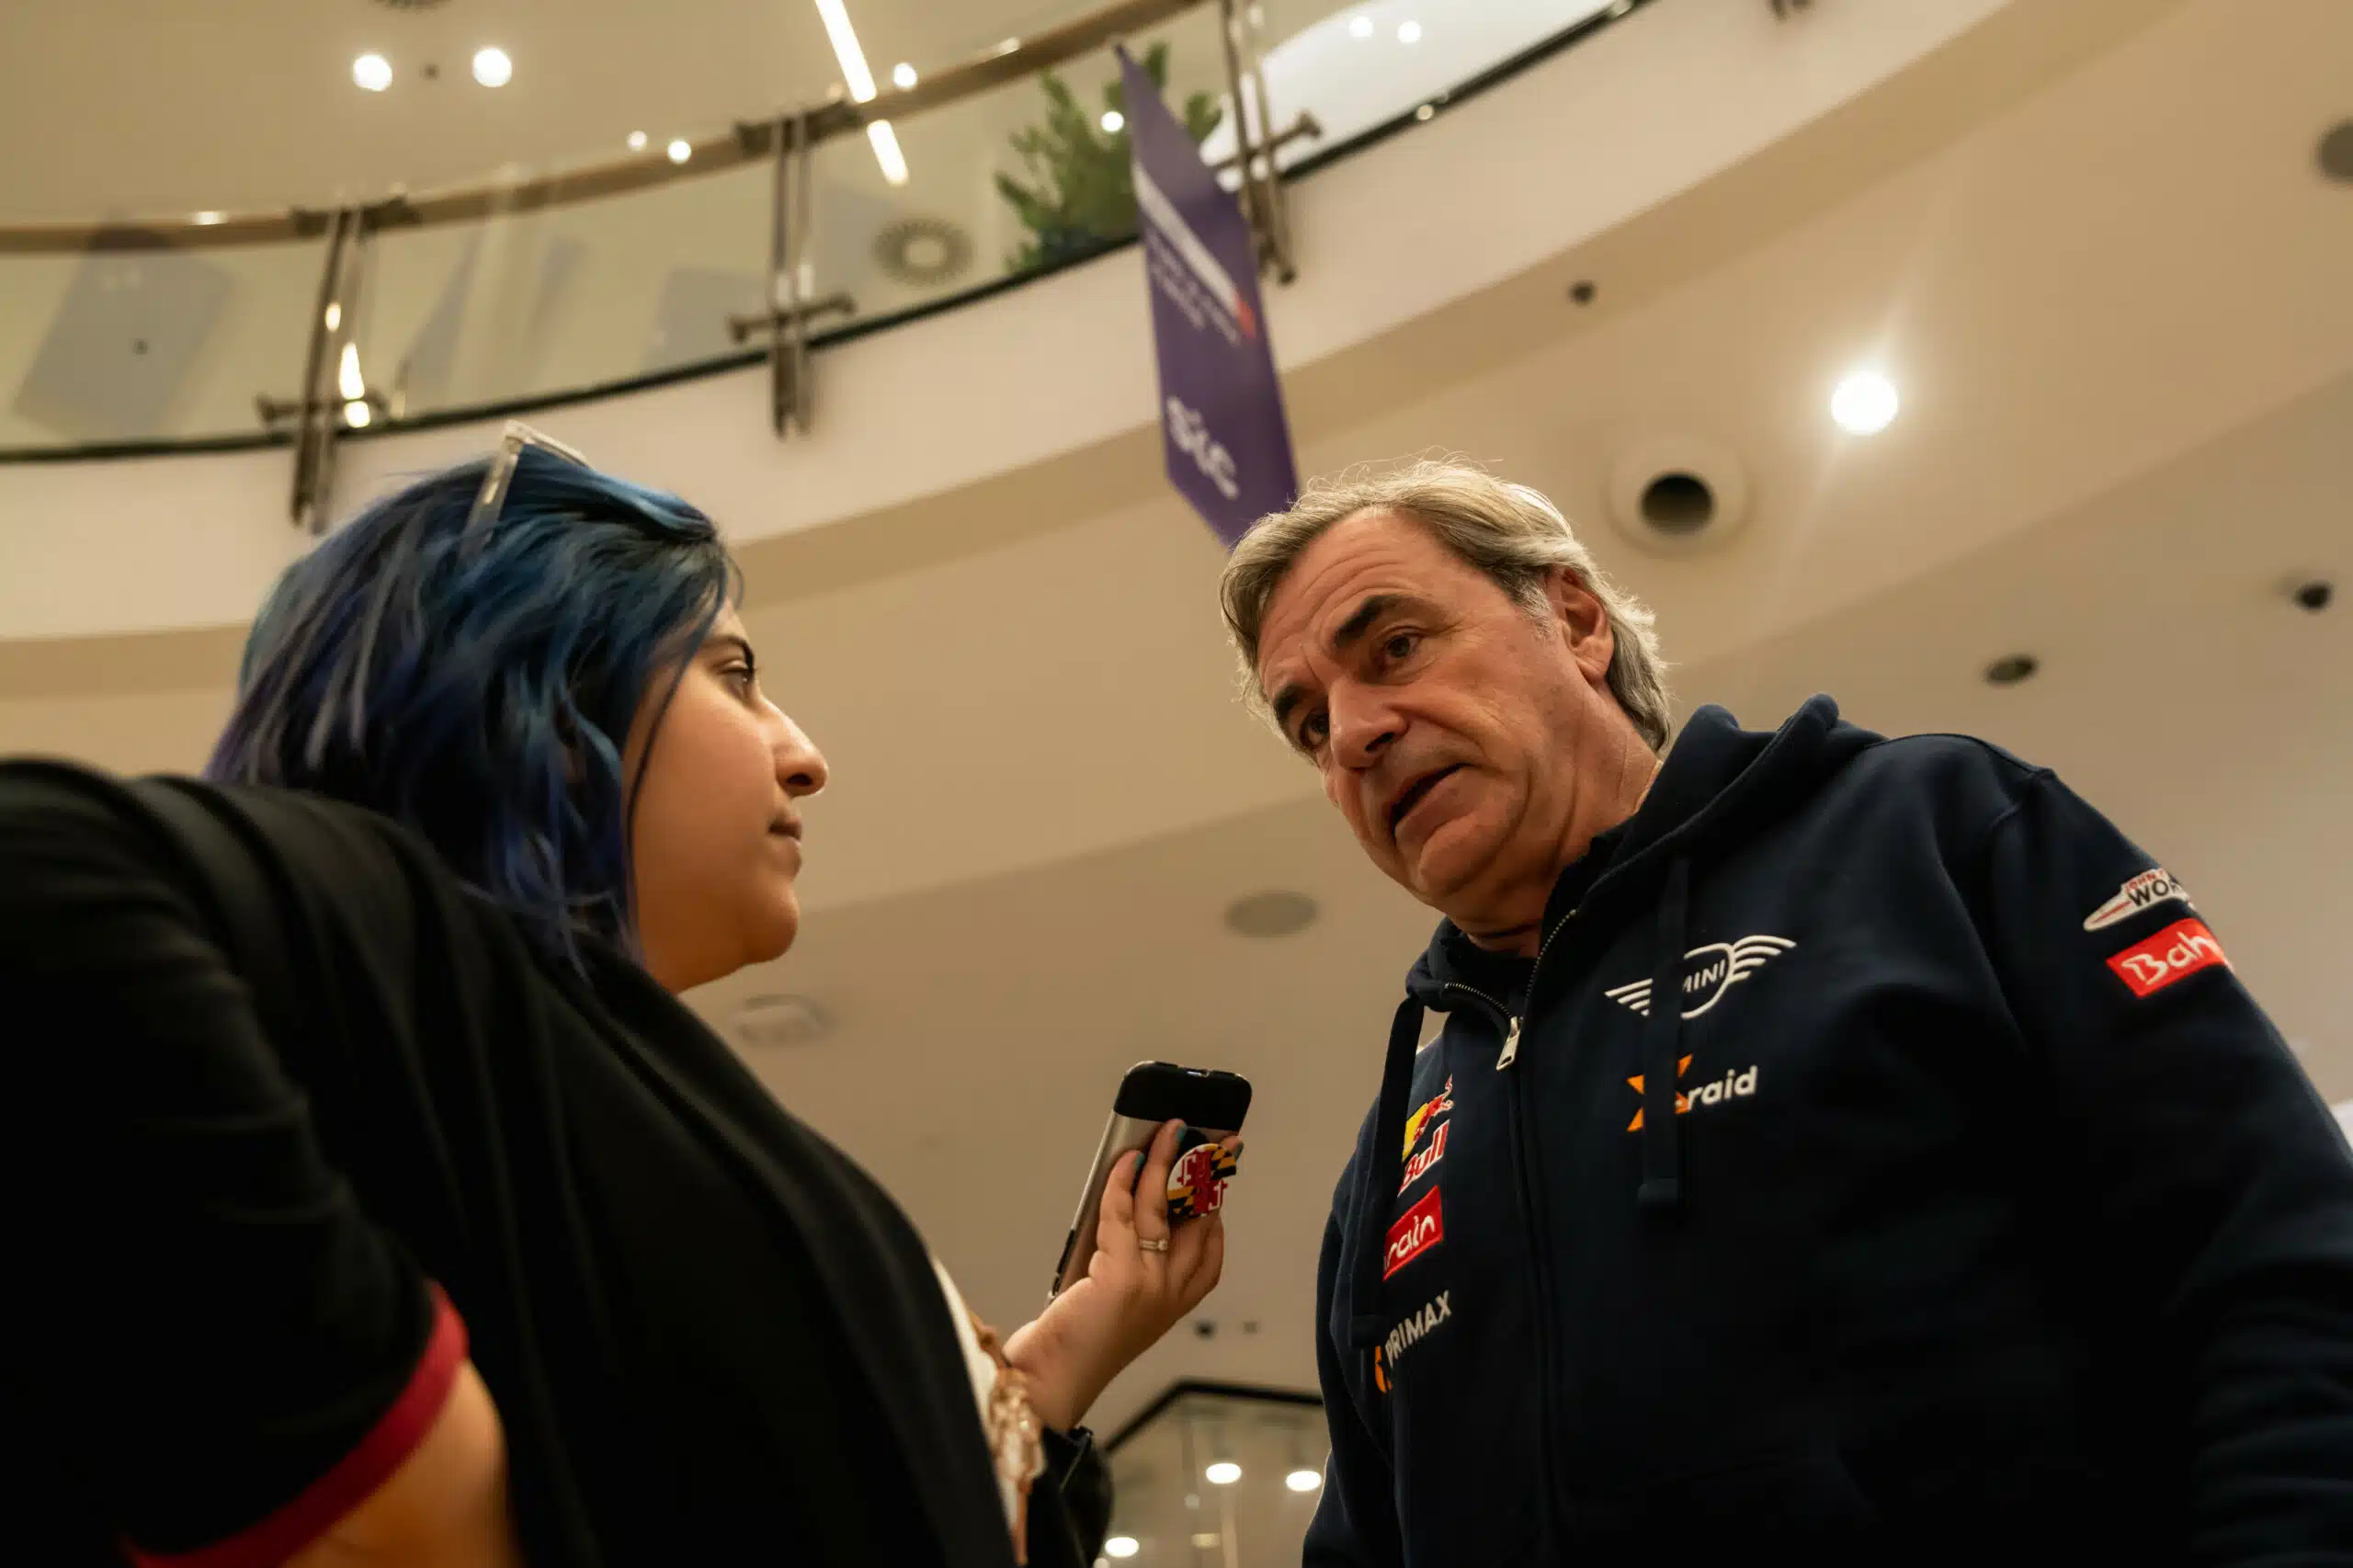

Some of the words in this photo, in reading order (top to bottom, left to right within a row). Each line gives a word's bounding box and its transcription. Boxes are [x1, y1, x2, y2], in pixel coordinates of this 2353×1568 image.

[1397, 1119, 1450, 1198] Bull
[1383, 1215, 1436, 1270] rain
[1384, 1290, 1452, 1369] PRIMAX
